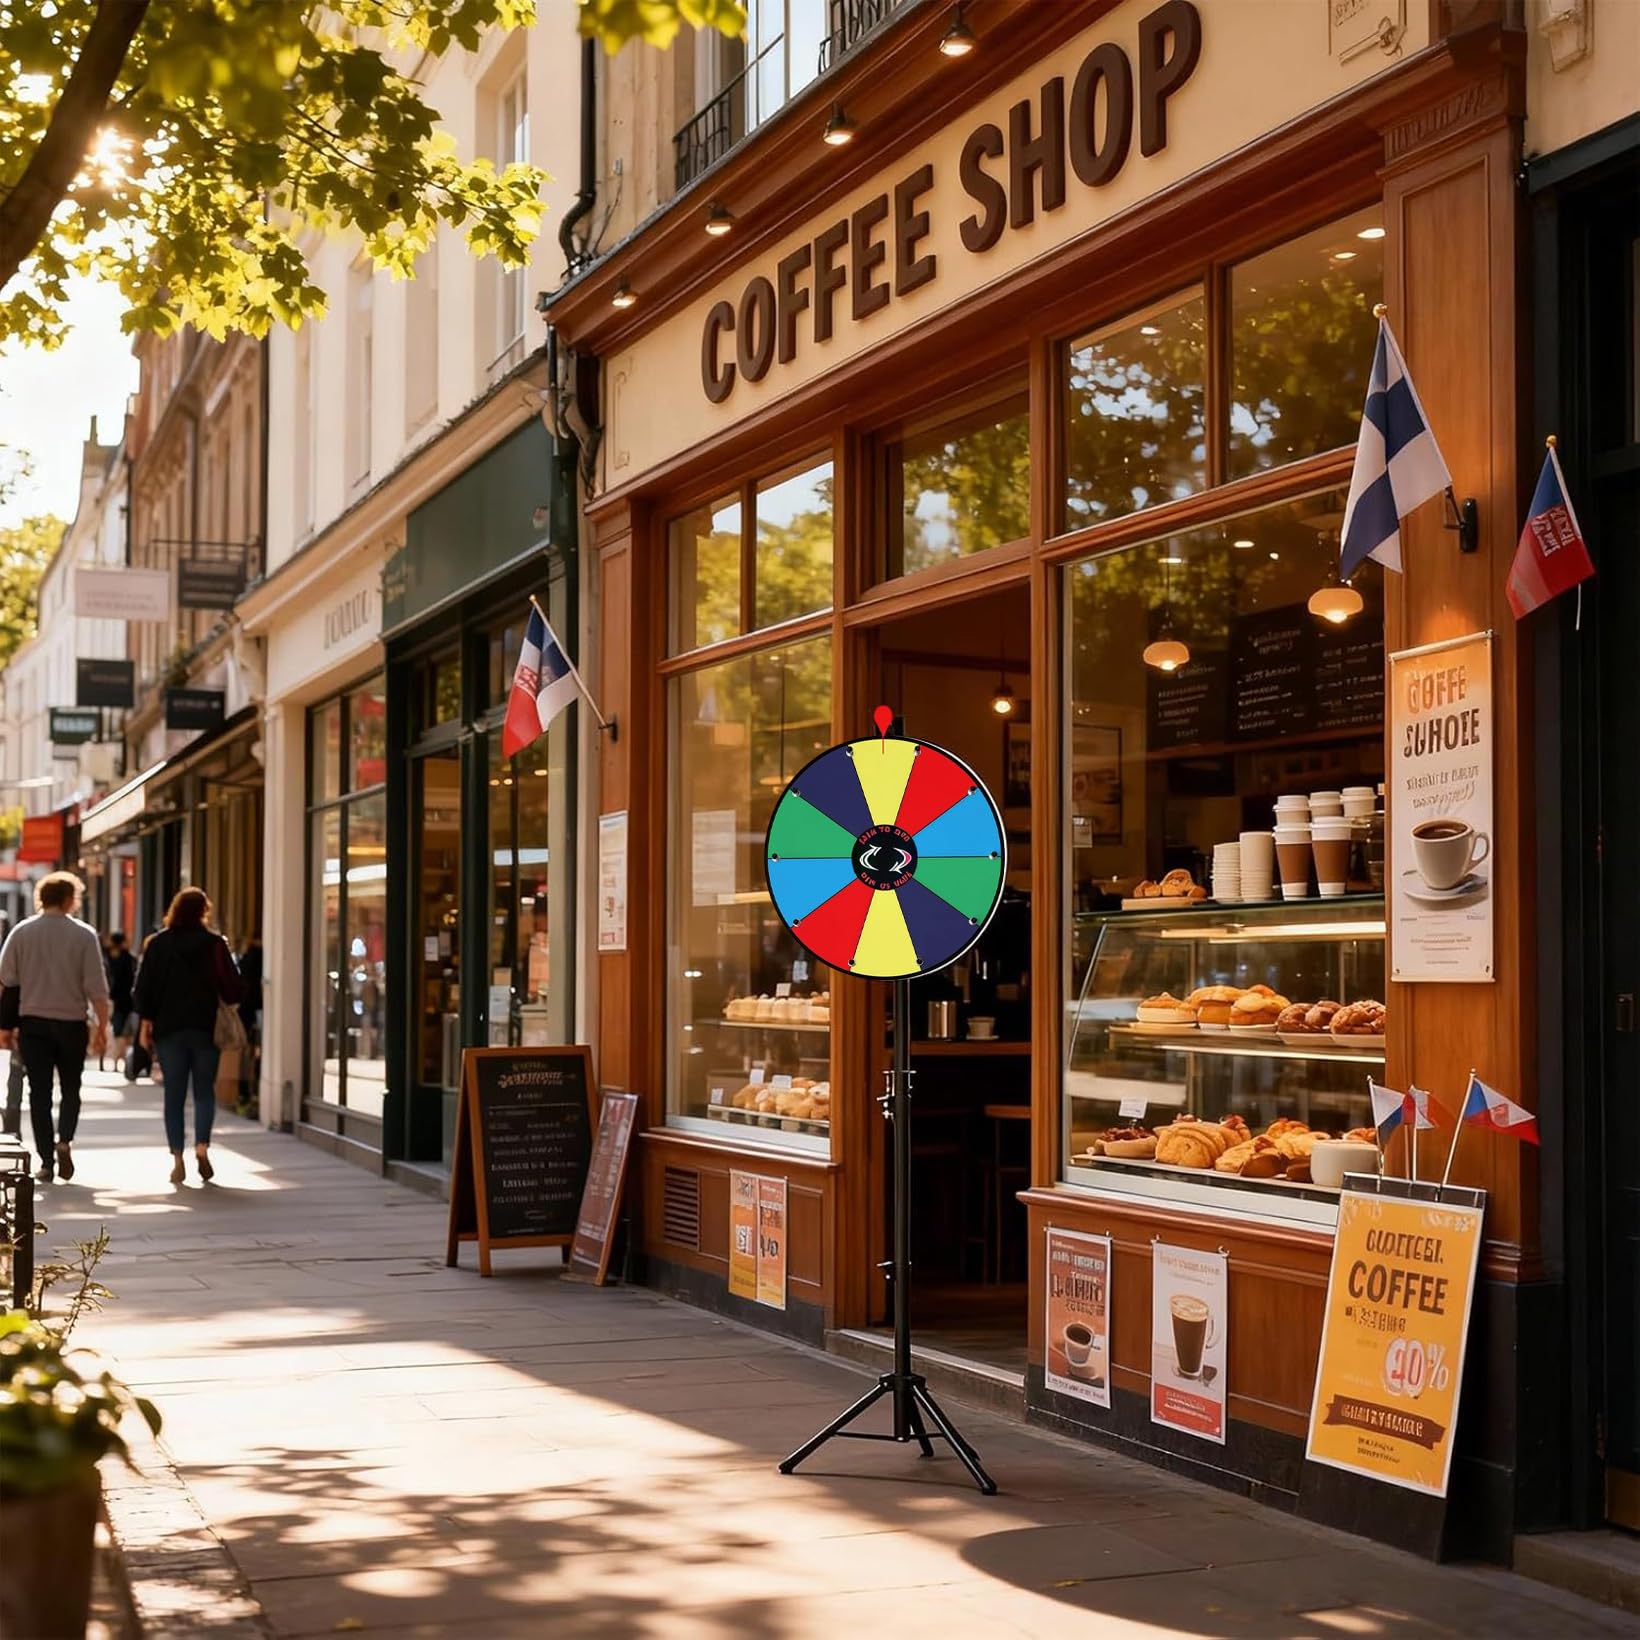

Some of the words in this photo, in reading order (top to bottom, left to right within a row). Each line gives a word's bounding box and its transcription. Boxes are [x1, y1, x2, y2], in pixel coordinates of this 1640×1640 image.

[701, 163, 937, 404] COFFEE
[959, 0, 1202, 253] SHOP
[1347, 1259, 1449, 1316] COFFEE
